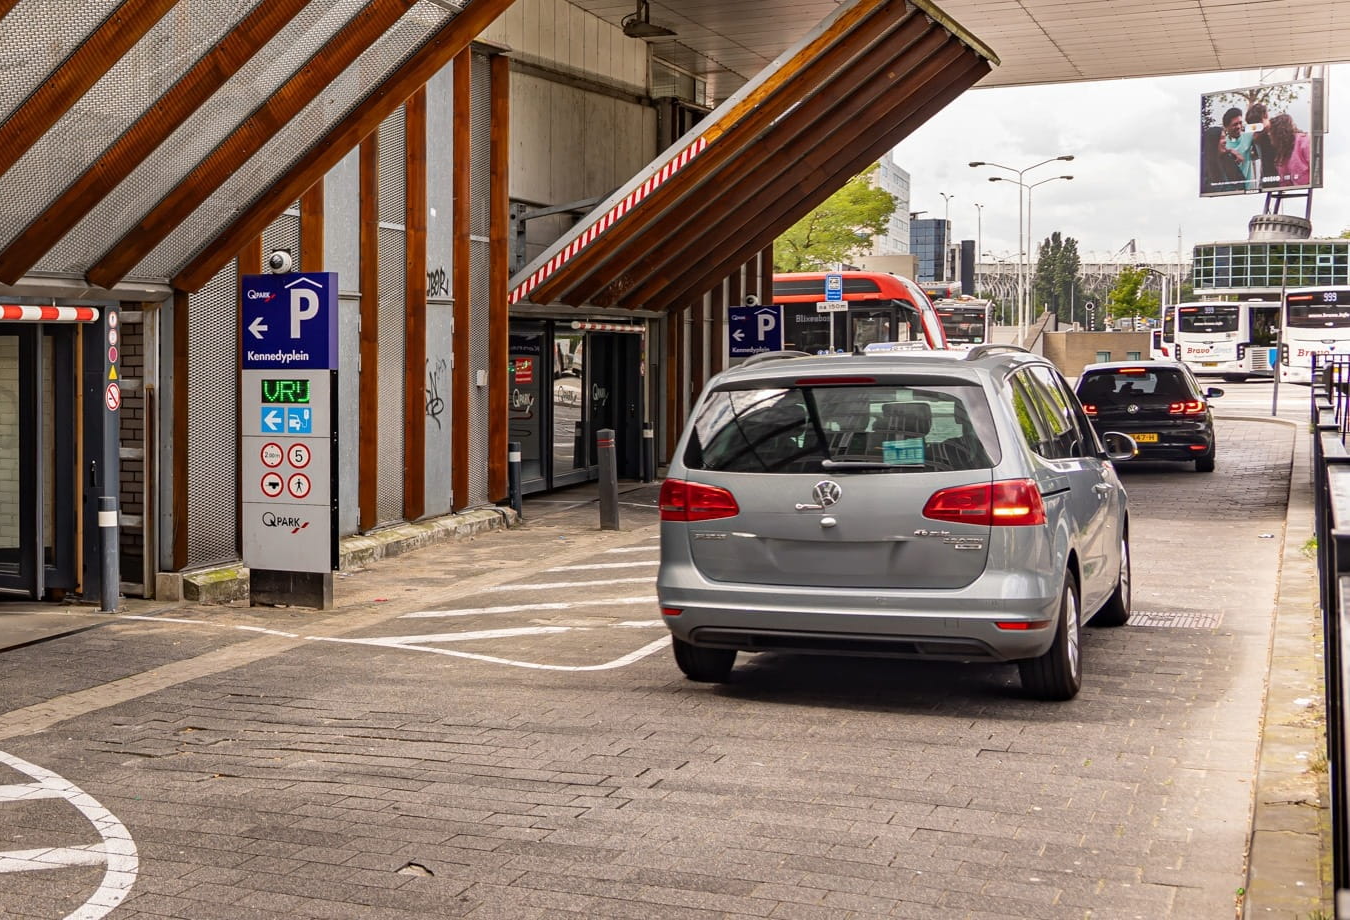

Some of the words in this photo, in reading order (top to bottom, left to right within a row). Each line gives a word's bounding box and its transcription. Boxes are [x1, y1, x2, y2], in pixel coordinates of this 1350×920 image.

[290, 288, 320, 339] P
[757, 313, 776, 341] P
[247, 349, 310, 364] Kennedyplein
[295, 449, 304, 463] 5
[262, 511, 300, 528] QPARK
